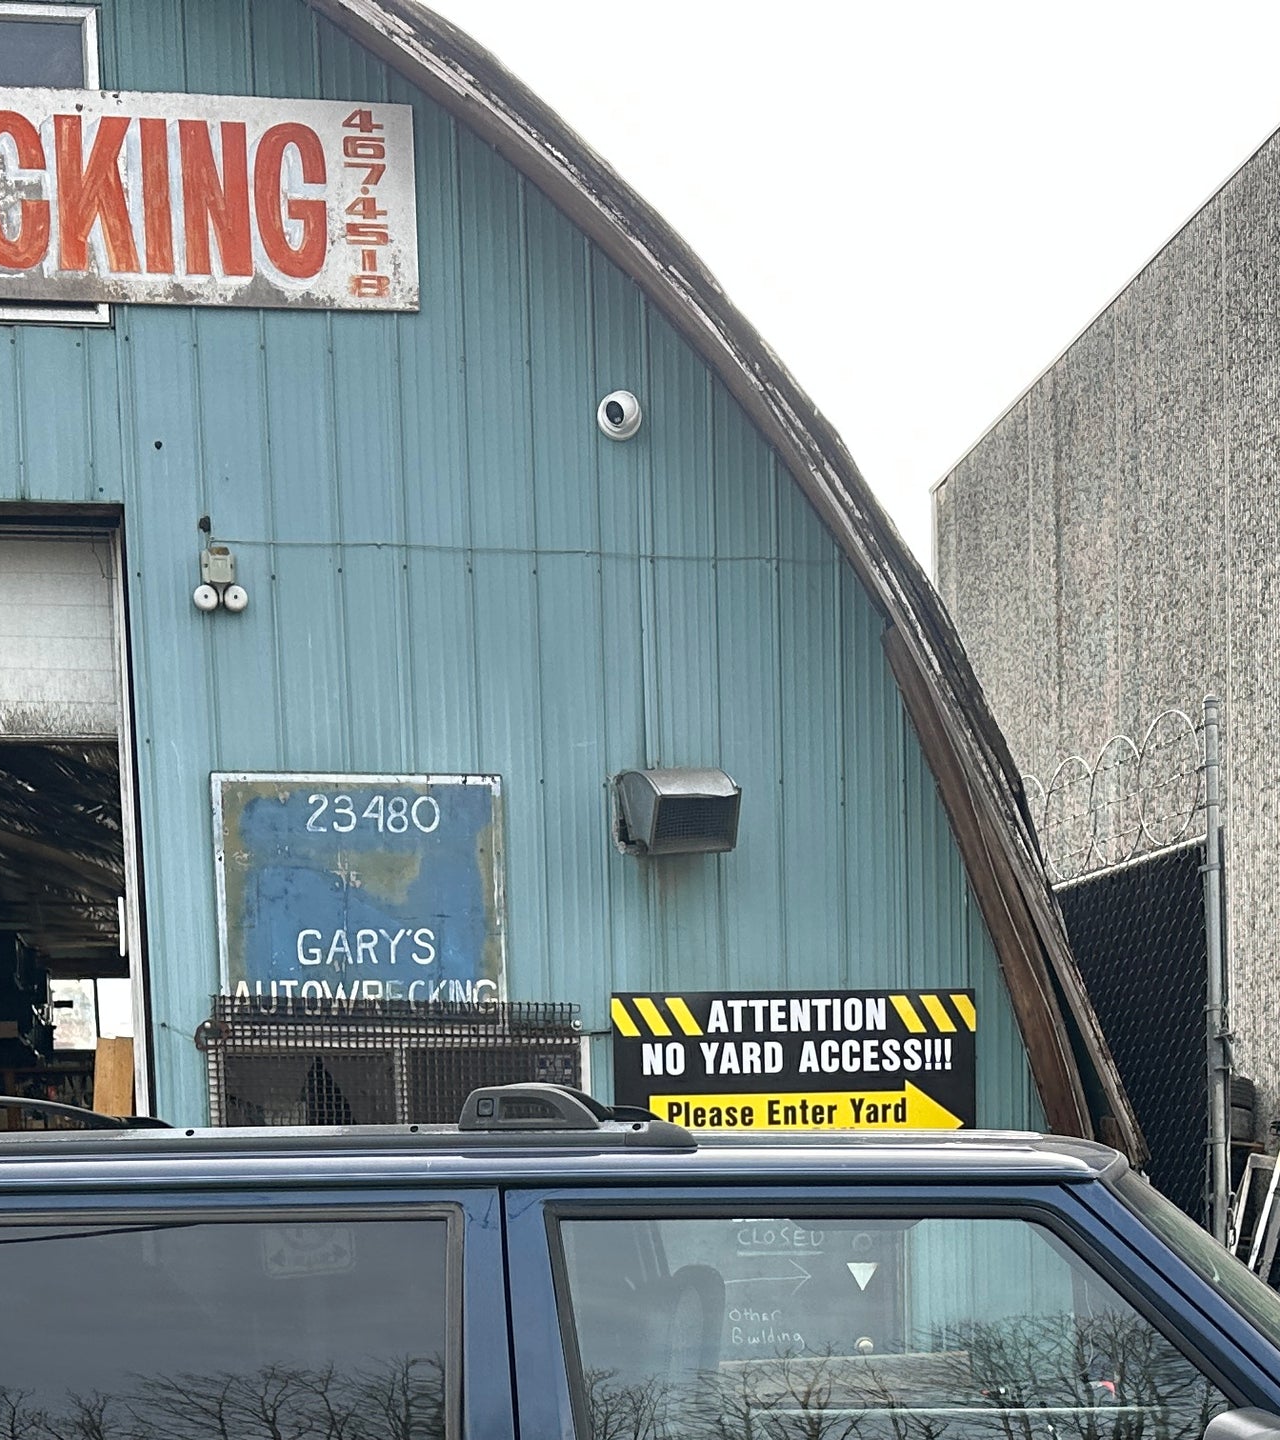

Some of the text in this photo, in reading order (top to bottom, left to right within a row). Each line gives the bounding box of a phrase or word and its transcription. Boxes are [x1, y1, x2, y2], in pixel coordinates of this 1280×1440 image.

[305, 794, 441, 834] 23480
[296, 928, 436, 965] GARY'S
[706, 997, 887, 1034] ATTENTION
[641, 1038, 953, 1076] NO YARD ACCESS!!!
[667, 1097, 907, 1127] Please Enter Yard
[737, 1226, 824, 1246] CLOSED
